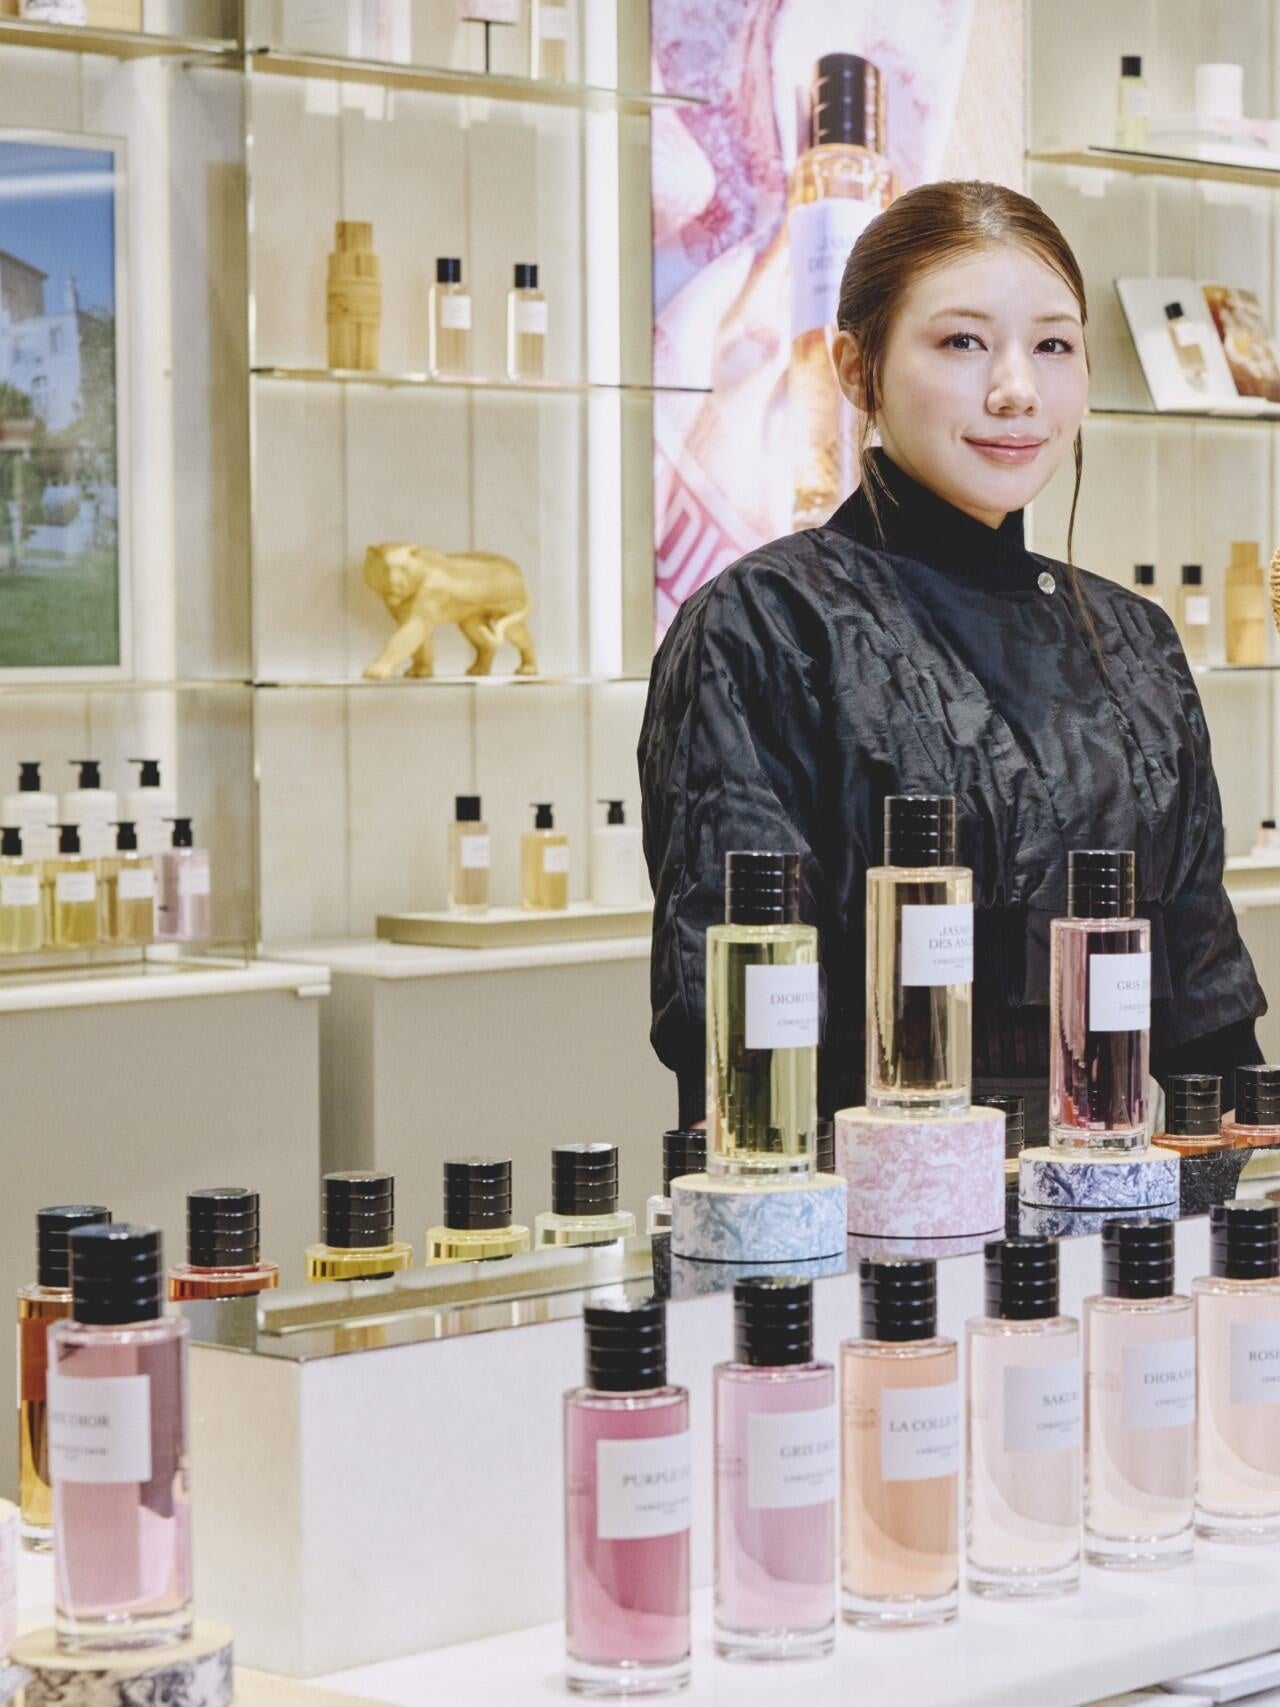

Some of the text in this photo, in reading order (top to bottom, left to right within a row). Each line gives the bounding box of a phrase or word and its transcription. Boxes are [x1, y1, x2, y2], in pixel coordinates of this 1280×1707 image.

[928, 938, 953, 951] DES
[1116, 979, 1141, 991] GRIS
[889, 1420, 909, 1433] LA
[779, 1442, 814, 1460] GRIS
[621, 1468, 676, 1489] PURPLE
